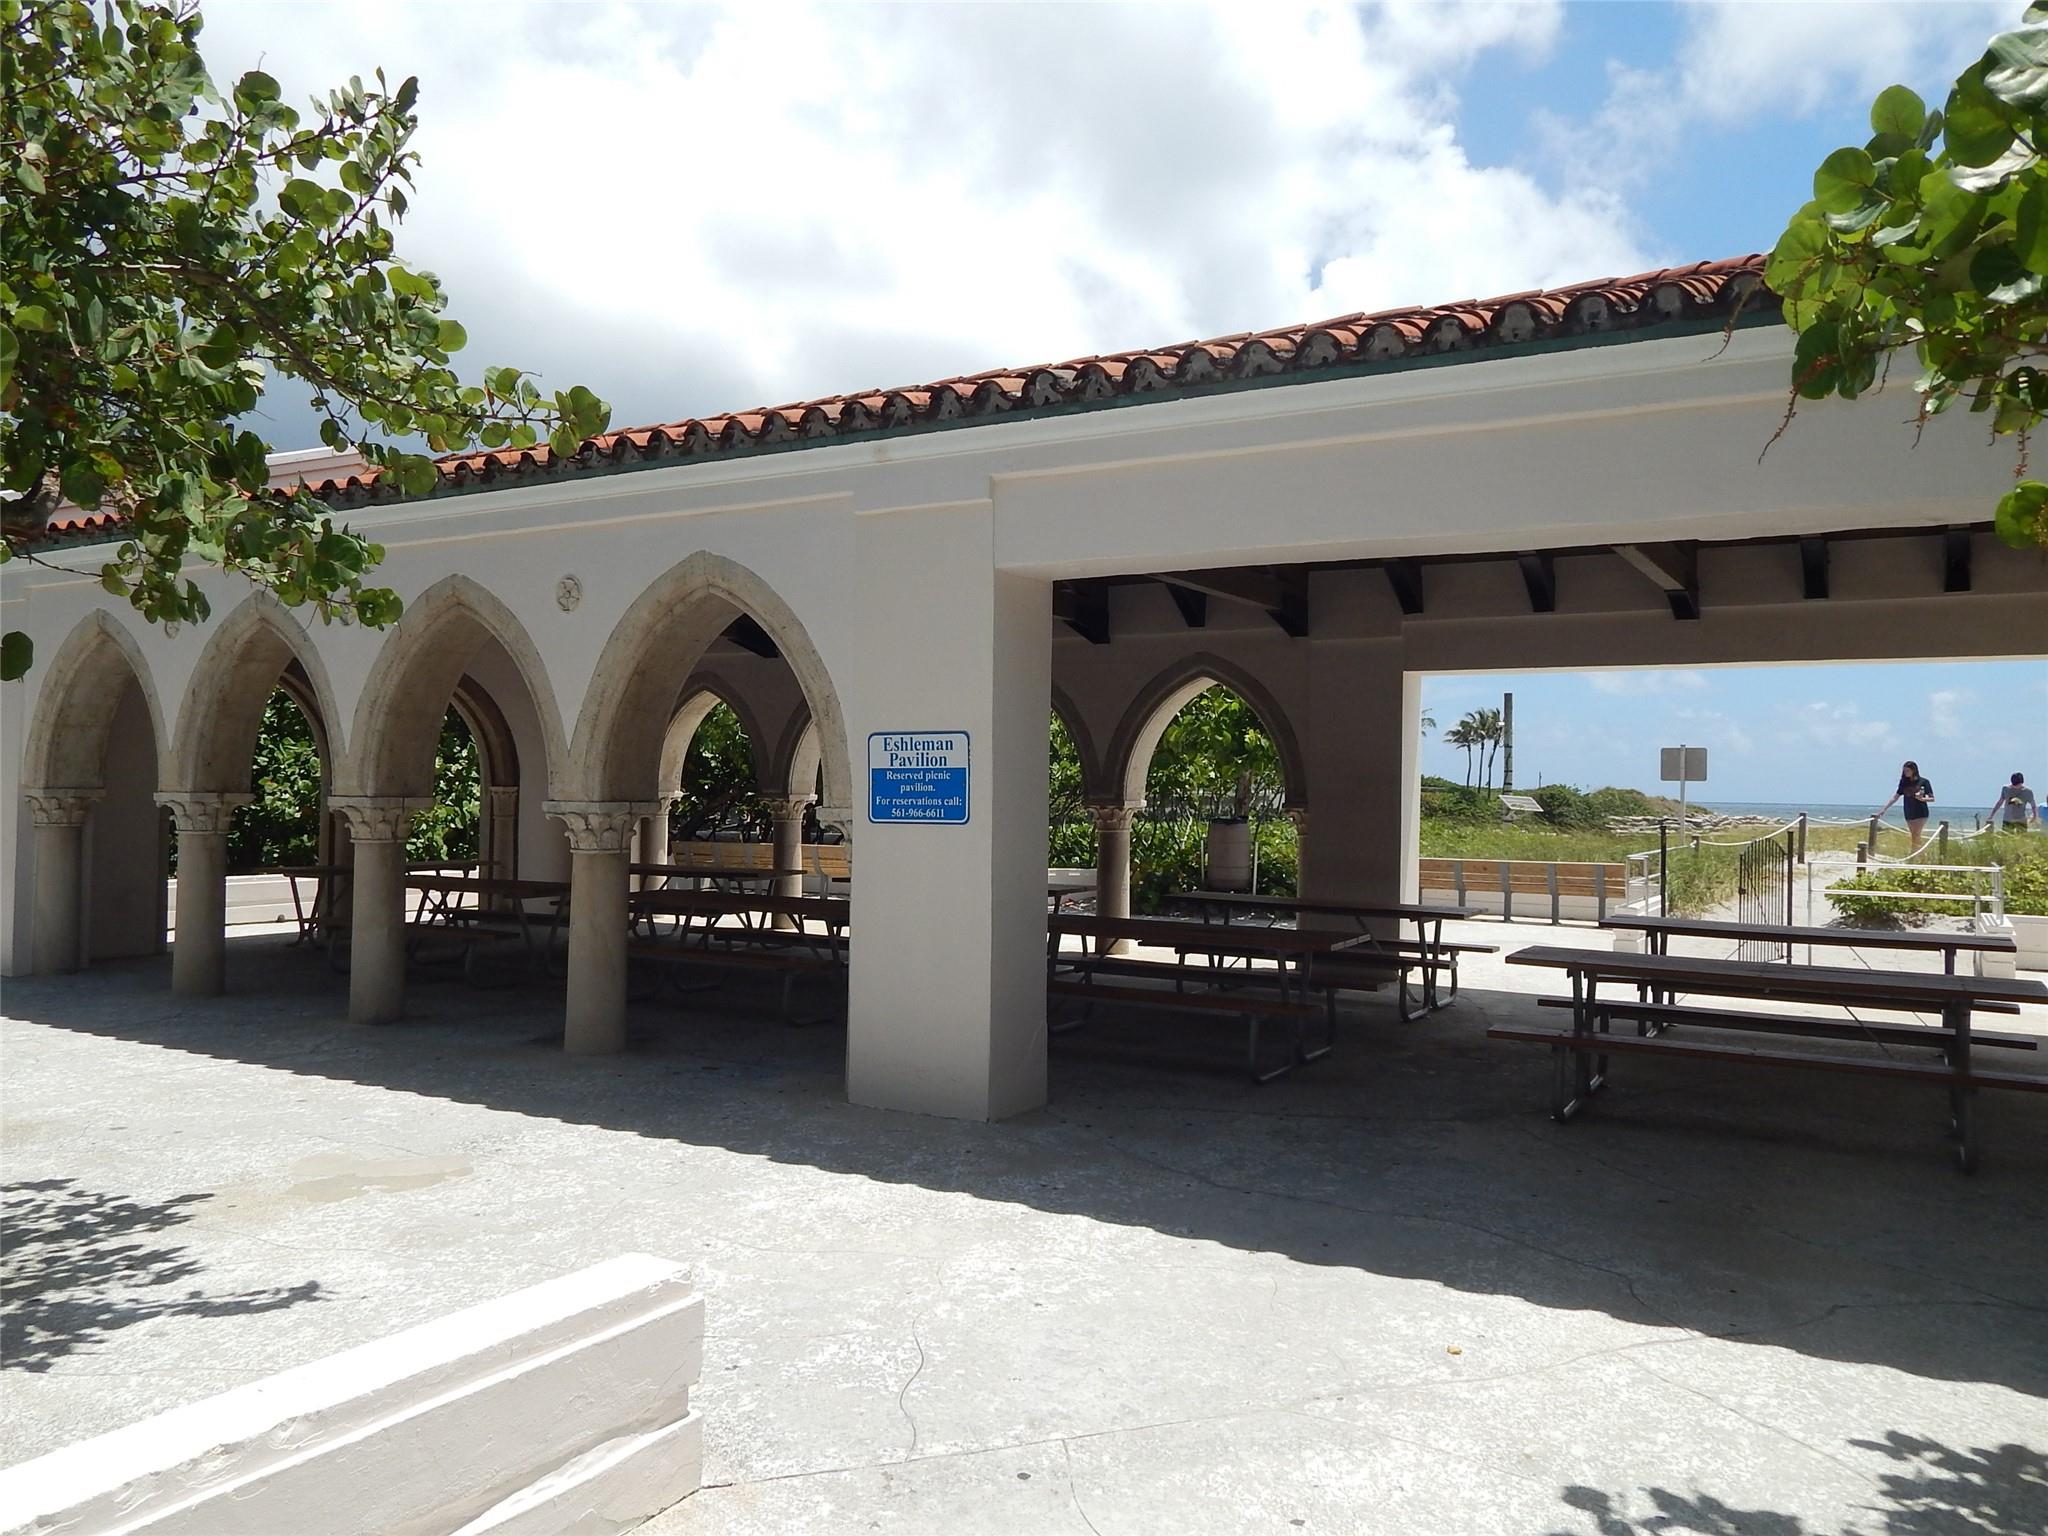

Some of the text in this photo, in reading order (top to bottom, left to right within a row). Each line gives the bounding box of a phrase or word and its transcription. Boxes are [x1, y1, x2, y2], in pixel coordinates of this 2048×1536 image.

[883, 736, 953, 752] Eshleman
[889, 752, 947, 767] Pavilion
[886, 770, 951, 782] Reserved picnic
[900, 782, 936, 794] pavilion.
[876, 796, 962, 806] For reservations call:
[891, 808, 944, 818] 561-966-6611
